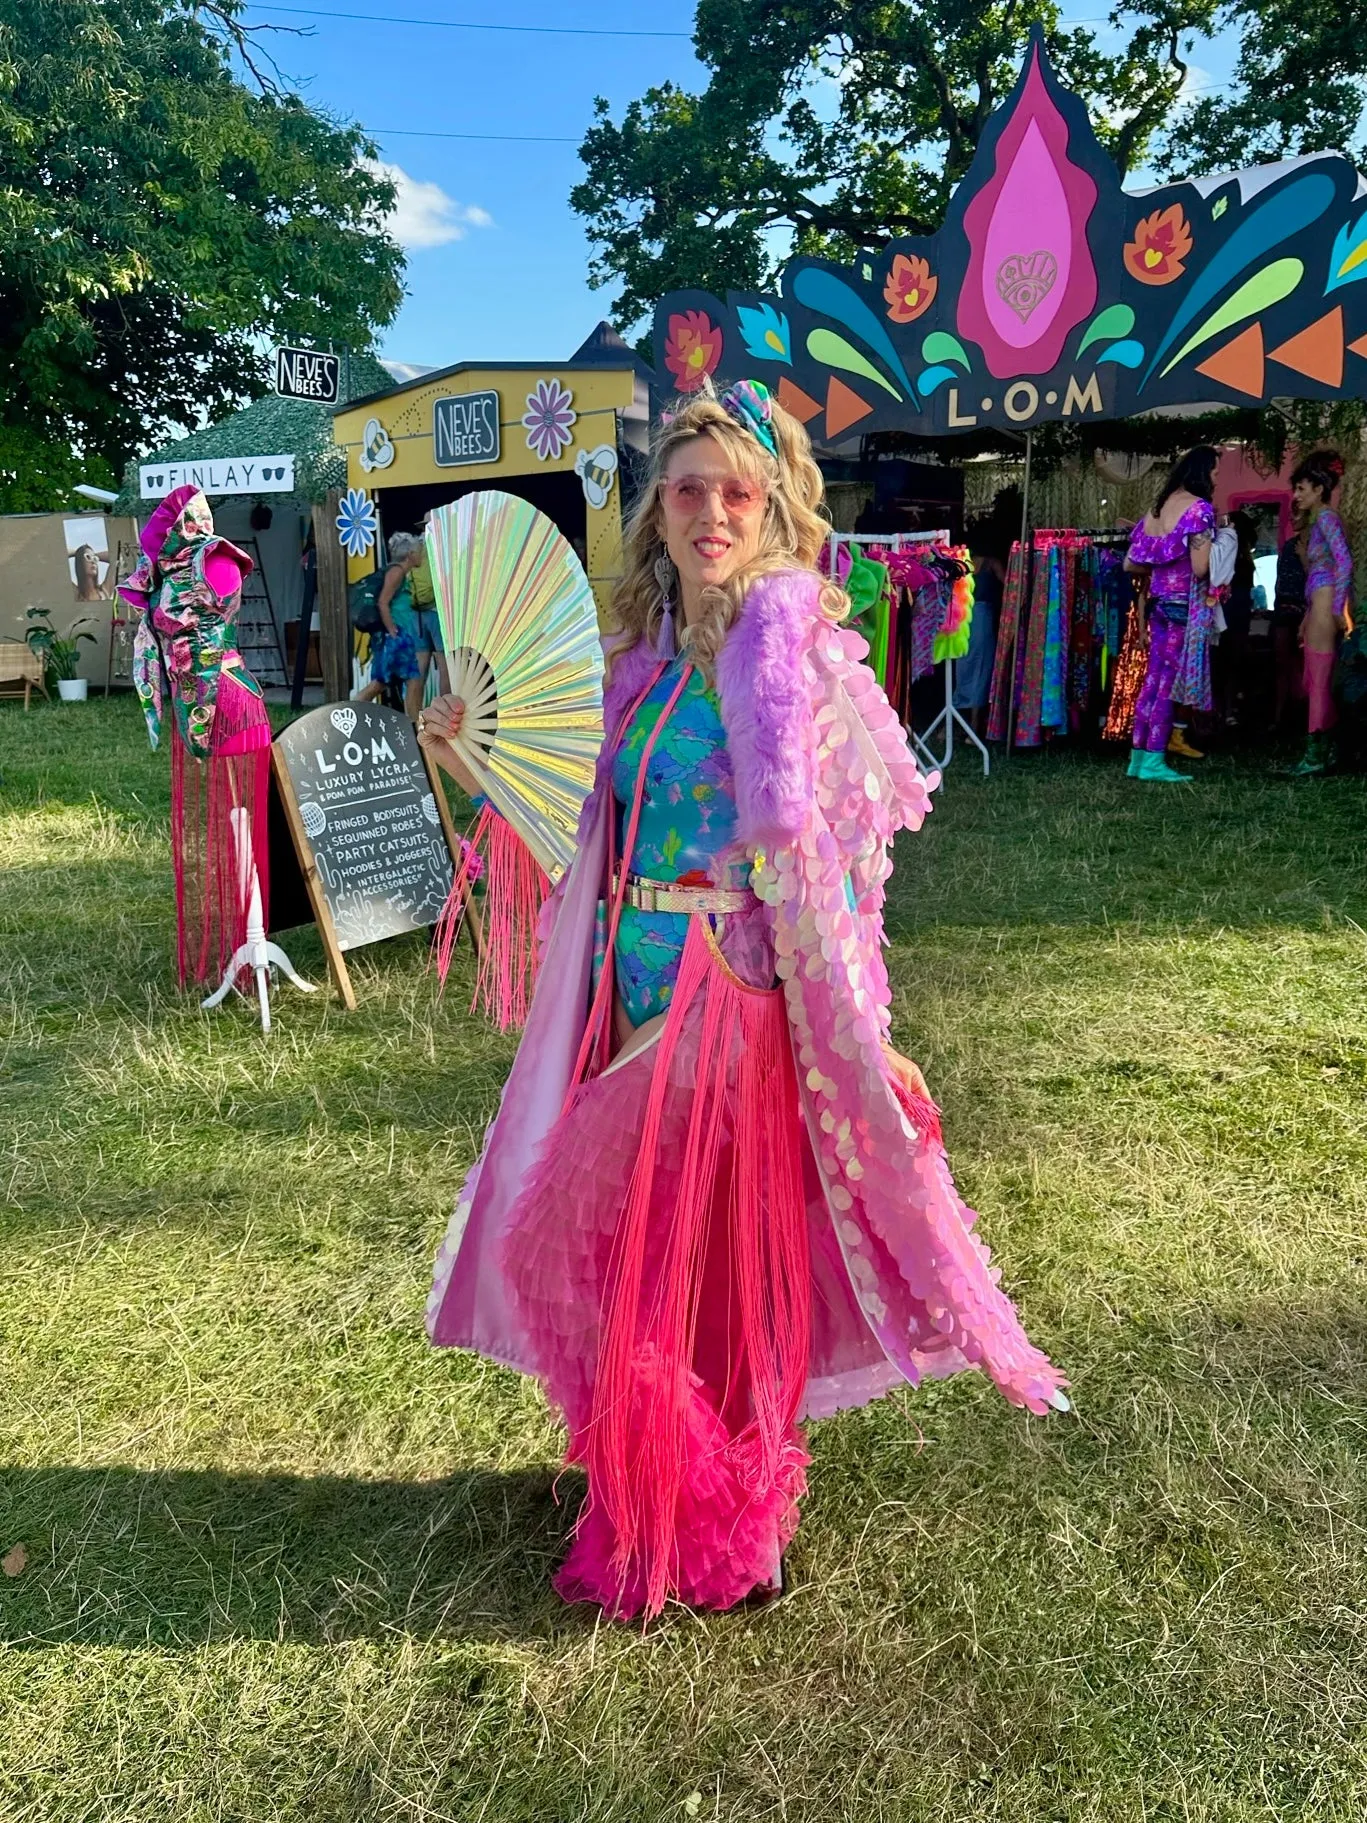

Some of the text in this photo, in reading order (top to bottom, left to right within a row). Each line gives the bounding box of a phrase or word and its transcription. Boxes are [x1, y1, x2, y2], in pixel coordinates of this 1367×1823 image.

[296, 378, 322, 396] BEES
[438, 398, 495, 457] NEVE'S
[454, 434, 482, 456] BEES
[169, 464, 255, 490] FINLAY
[316, 763, 410, 791] LUXURY LYCRA
[326, 790, 346, 801] POM
[347, 786, 366, 796] POM
[369, 775, 413, 791] PARADISE!
[327, 803, 420, 833] FRINGED BODYSUITS
[331, 825, 388, 847] SEQUINNED
[335, 832, 430, 864] PARTY CATSUITS
[341, 847, 432, 878] HOODIES & JOGGERS
[357, 863, 426, 888] INTERGALACTIC
